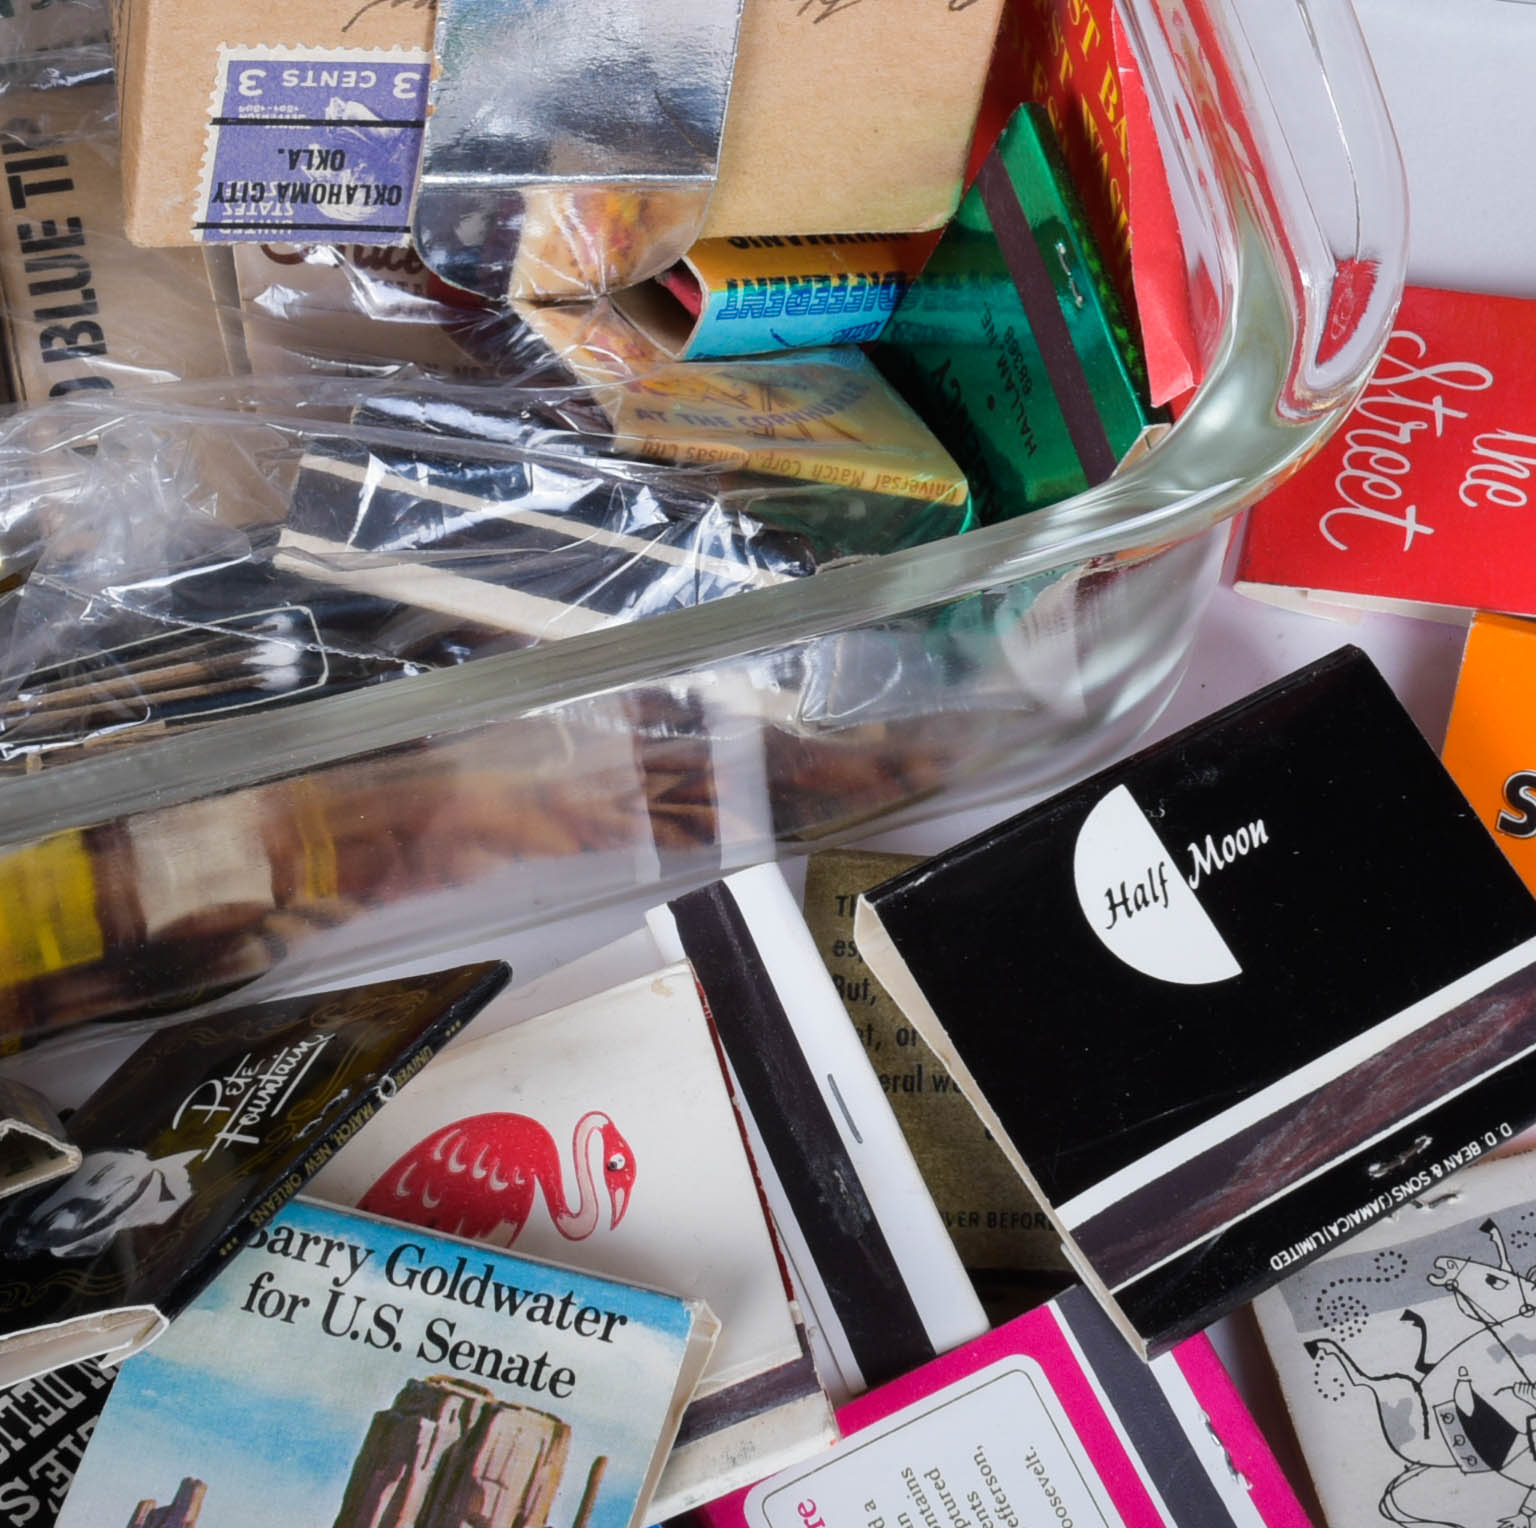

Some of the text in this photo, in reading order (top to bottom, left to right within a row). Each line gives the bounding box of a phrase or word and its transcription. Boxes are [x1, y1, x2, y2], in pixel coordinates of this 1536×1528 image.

[238, 68, 421, 99] 3 CENTS 3
[211, 181, 403, 207] OKLAHOMA CITY
[277, 147, 345, 173] OKLA.
[17, 214, 109, 365] BLUE
[811, 462, 865, 488] Match
[874, 472, 960, 503] Universal
[1319, 330, 1494, 553] Street
[1104, 818, 1271, 931] Half Moon
[248, 1141, 334, 1229] NEW ORLEANS
[1269, 1140, 1482, 1271] BEAN & SONS (JAMAICA) LIMITED
[240, 1270, 579, 1399] for U.S. Senate
[384, 1241, 629, 1345] Goldwater
